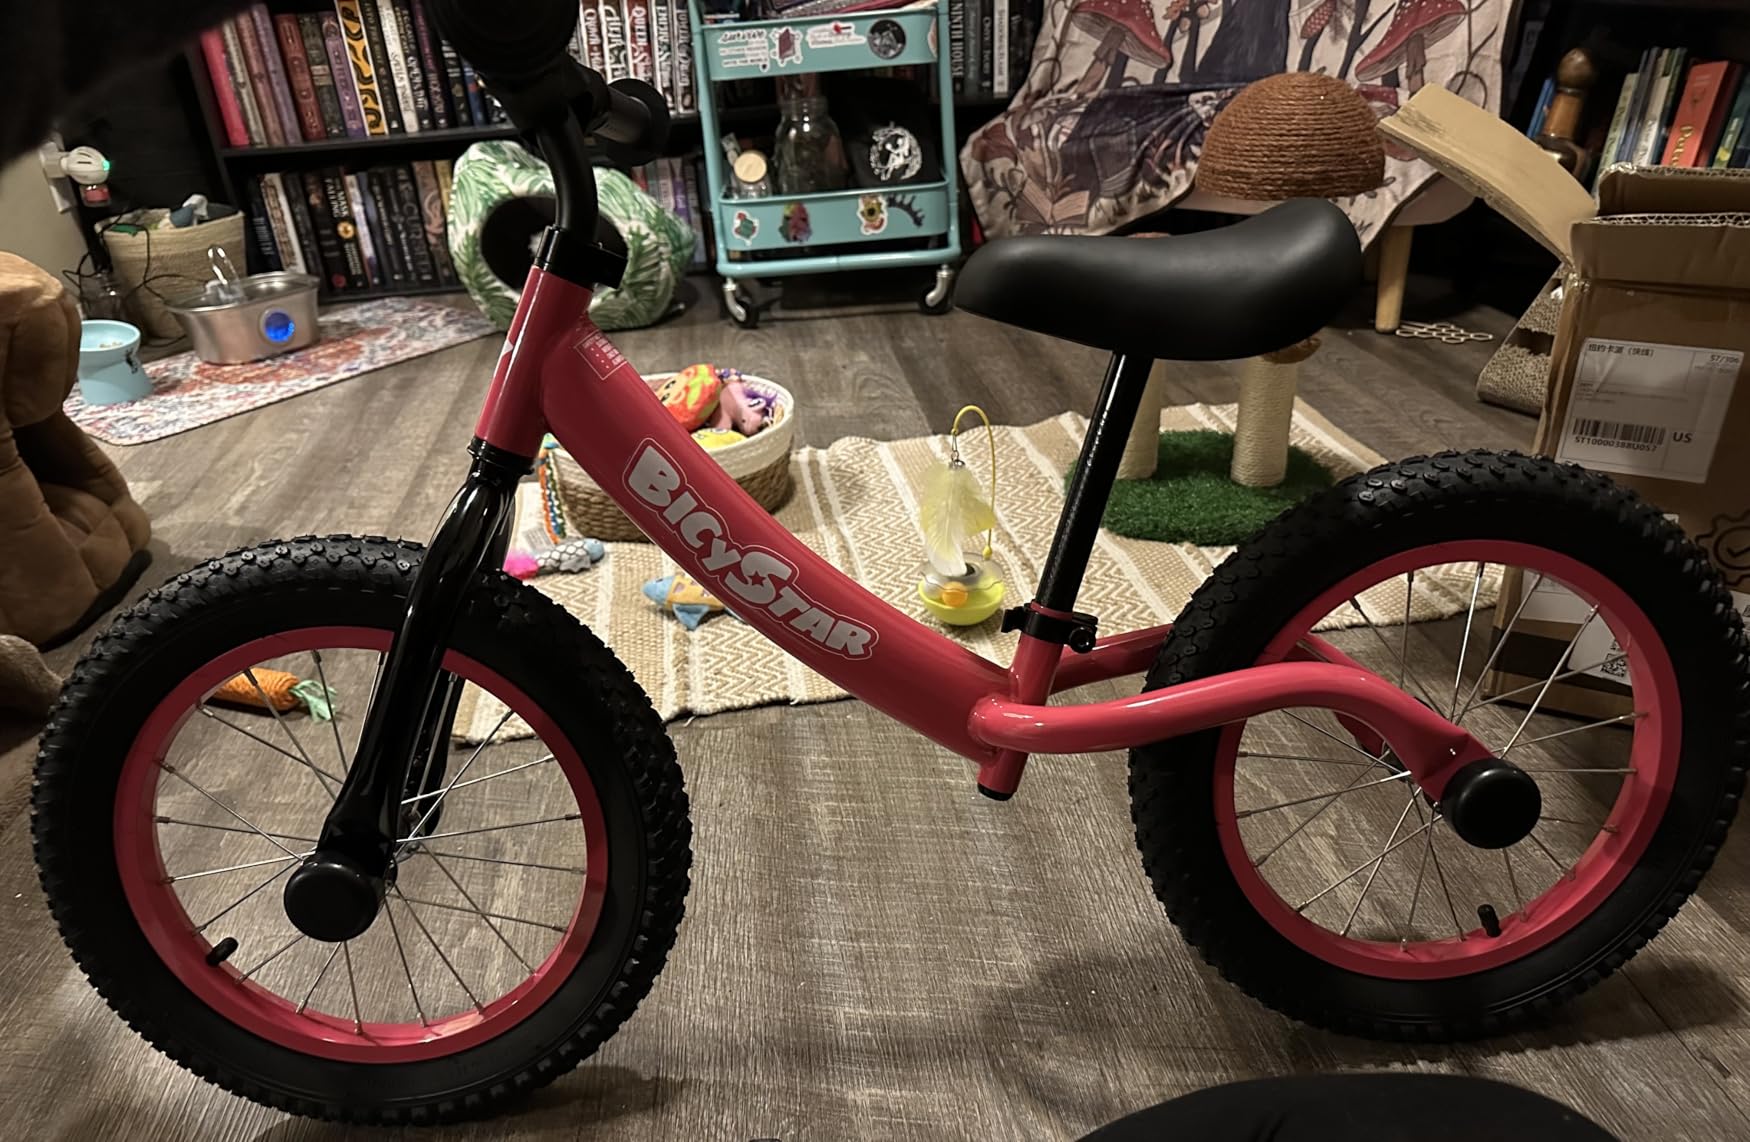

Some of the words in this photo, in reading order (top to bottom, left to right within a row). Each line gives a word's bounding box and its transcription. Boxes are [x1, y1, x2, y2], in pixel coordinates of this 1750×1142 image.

[950, 3, 964, 39] NINTH
[951, 42, 964, 77] HOUSE
[1672, 431, 1694, 443] US
